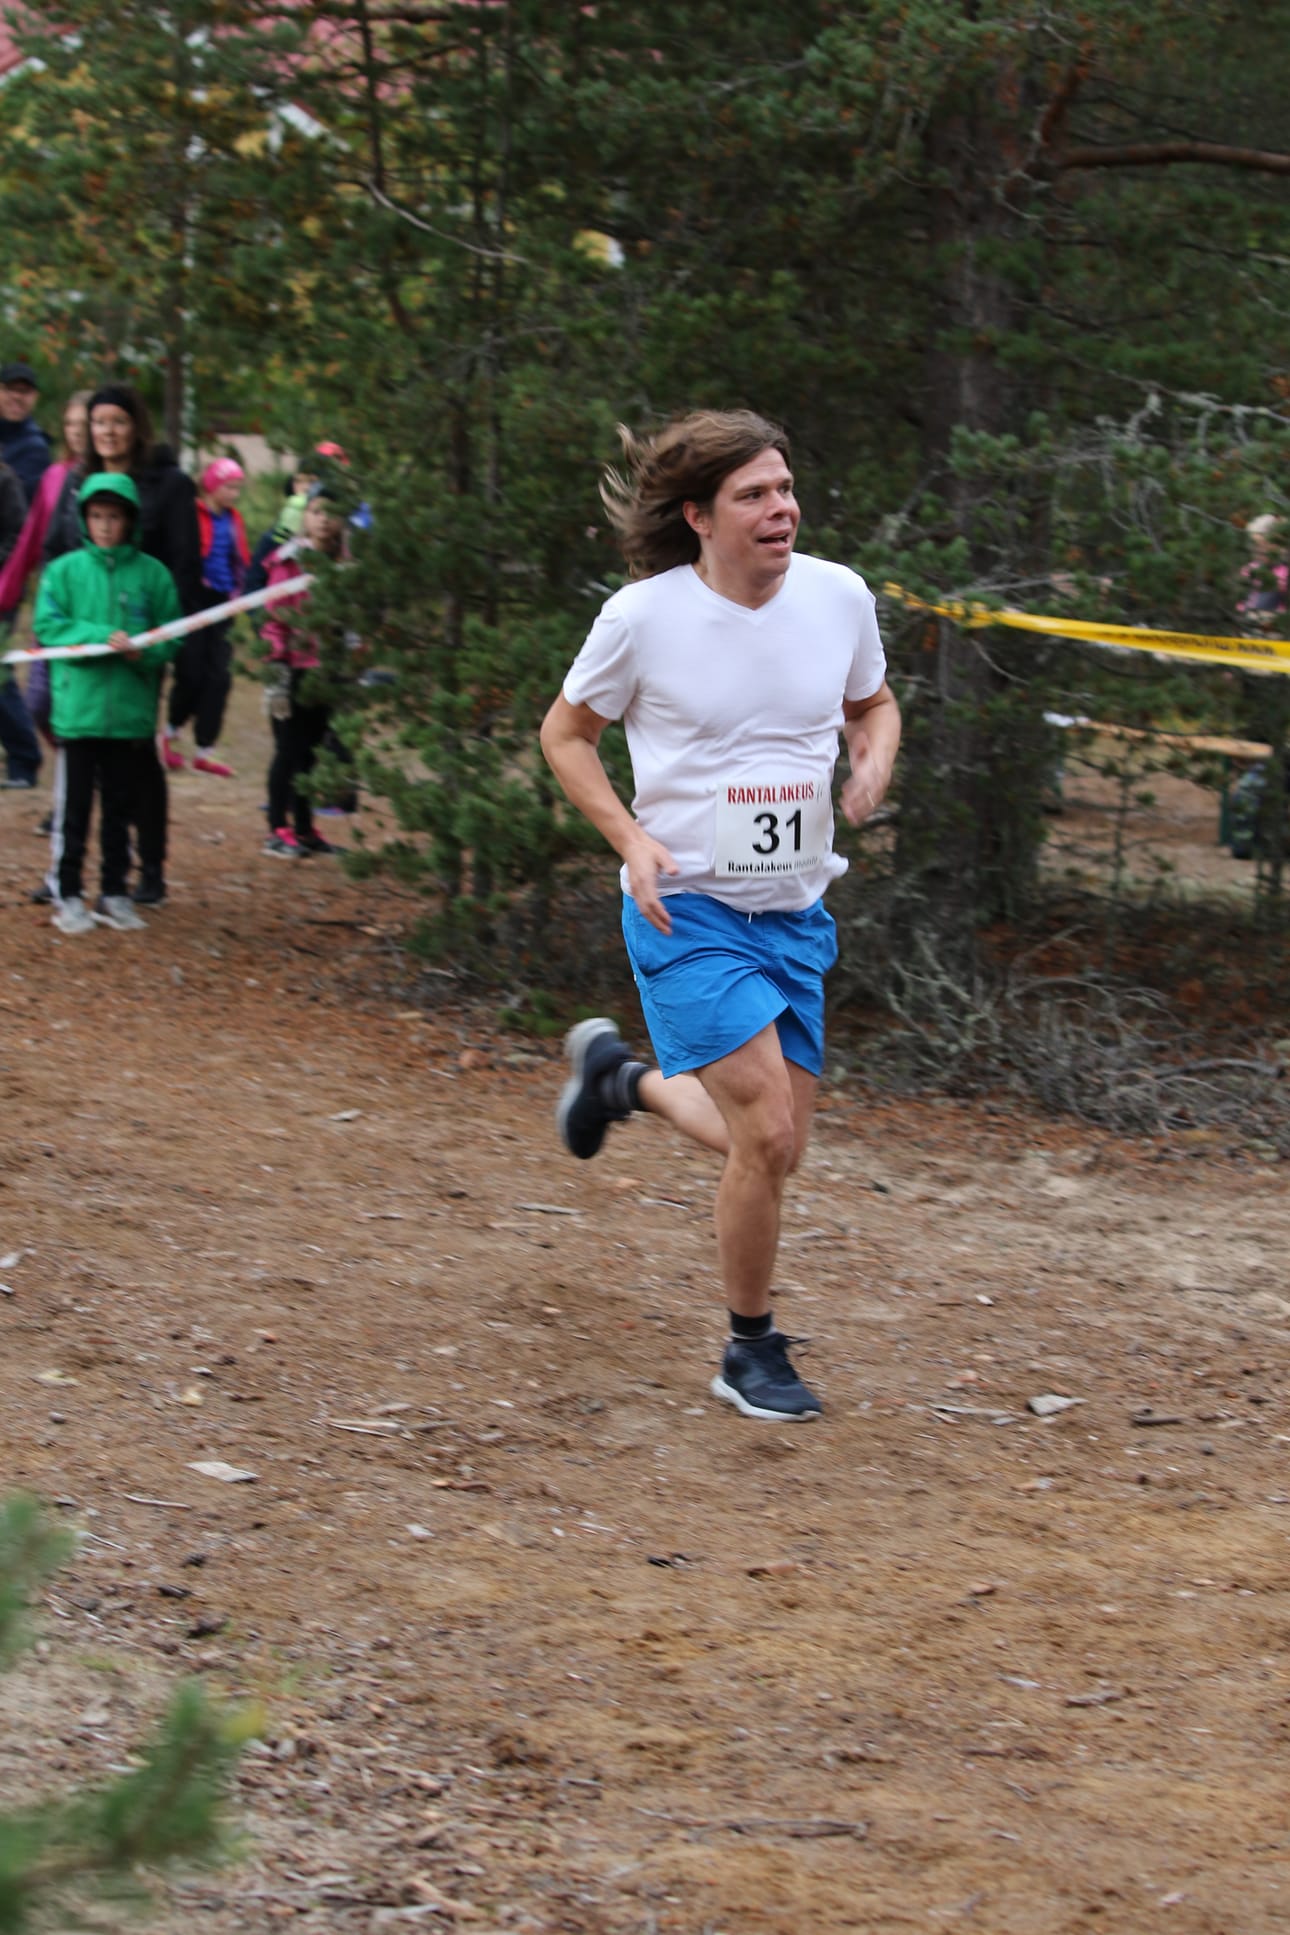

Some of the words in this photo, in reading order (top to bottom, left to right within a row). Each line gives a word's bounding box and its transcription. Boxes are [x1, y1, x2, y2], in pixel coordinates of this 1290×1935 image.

[727, 781, 814, 805] RANTALAKEUS
[752, 808, 802, 855] 31
[728, 860, 792, 873] Rantalakeus
